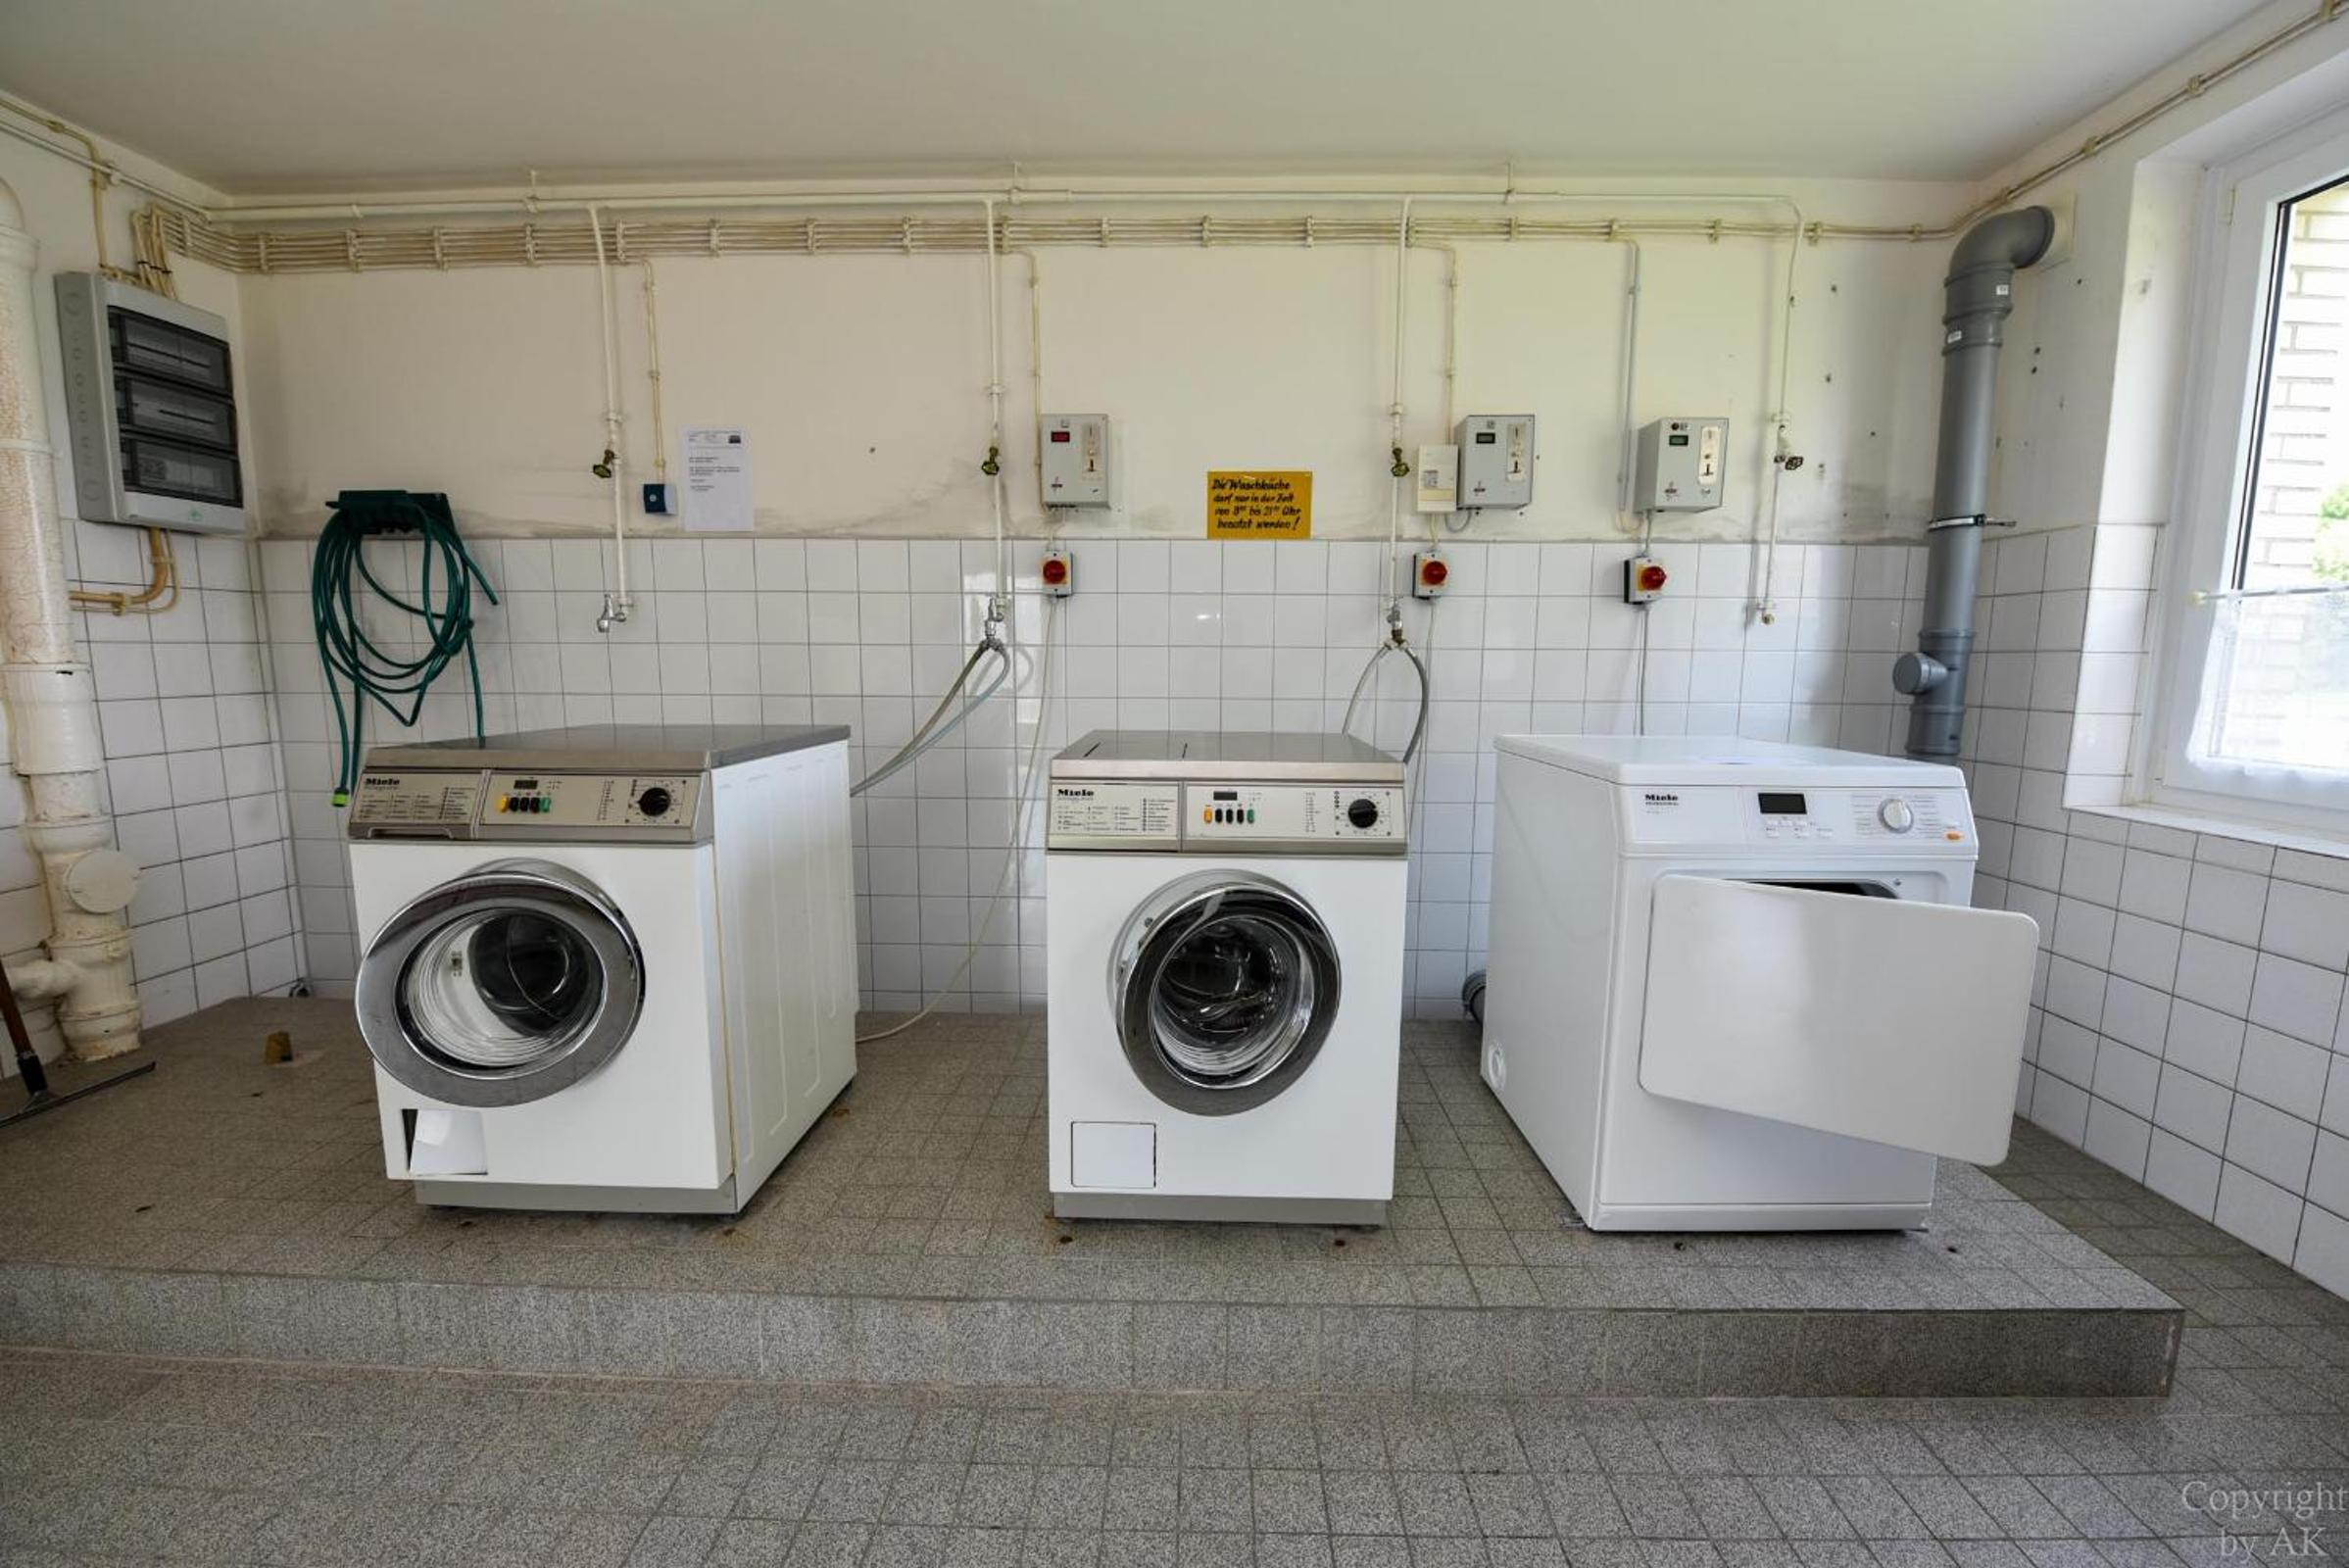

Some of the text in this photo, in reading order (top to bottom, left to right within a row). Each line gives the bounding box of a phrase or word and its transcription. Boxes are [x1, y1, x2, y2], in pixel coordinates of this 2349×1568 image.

[1213, 493, 1233, 504] darf
[1250, 493, 1259, 503] in
[1260, 493, 1275, 503] der
[1276, 493, 1295, 503] Zeit
[1249, 506, 1261, 515] bis
[1057, 788, 1094, 797] Miele
